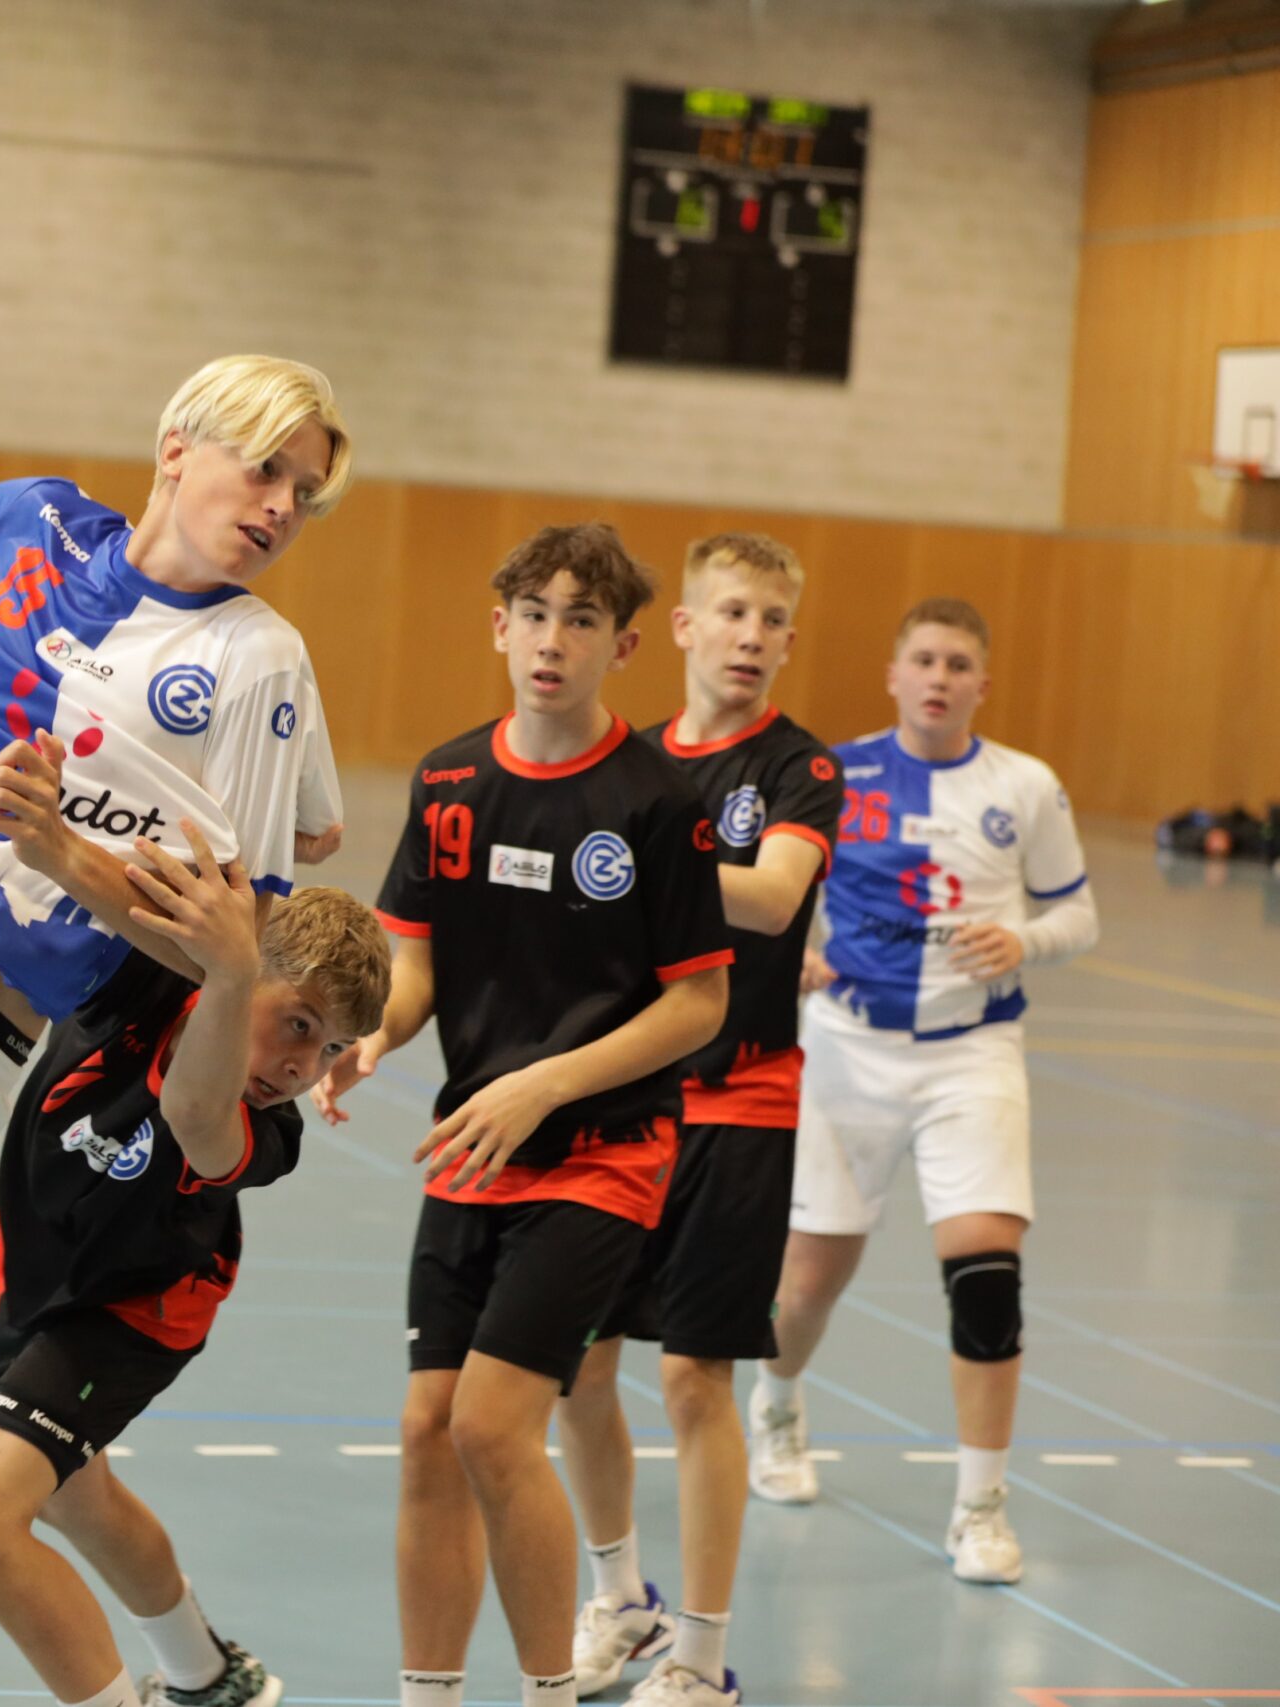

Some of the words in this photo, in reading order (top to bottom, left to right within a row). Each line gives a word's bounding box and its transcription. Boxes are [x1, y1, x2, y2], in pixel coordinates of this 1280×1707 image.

[39, 503, 91, 563] Kempa
[423, 802, 473, 880] 19
[836, 788, 891, 843] 26
[29, 1409, 75, 1443] Kempa
[536, 1675, 576, 1688] Kem
